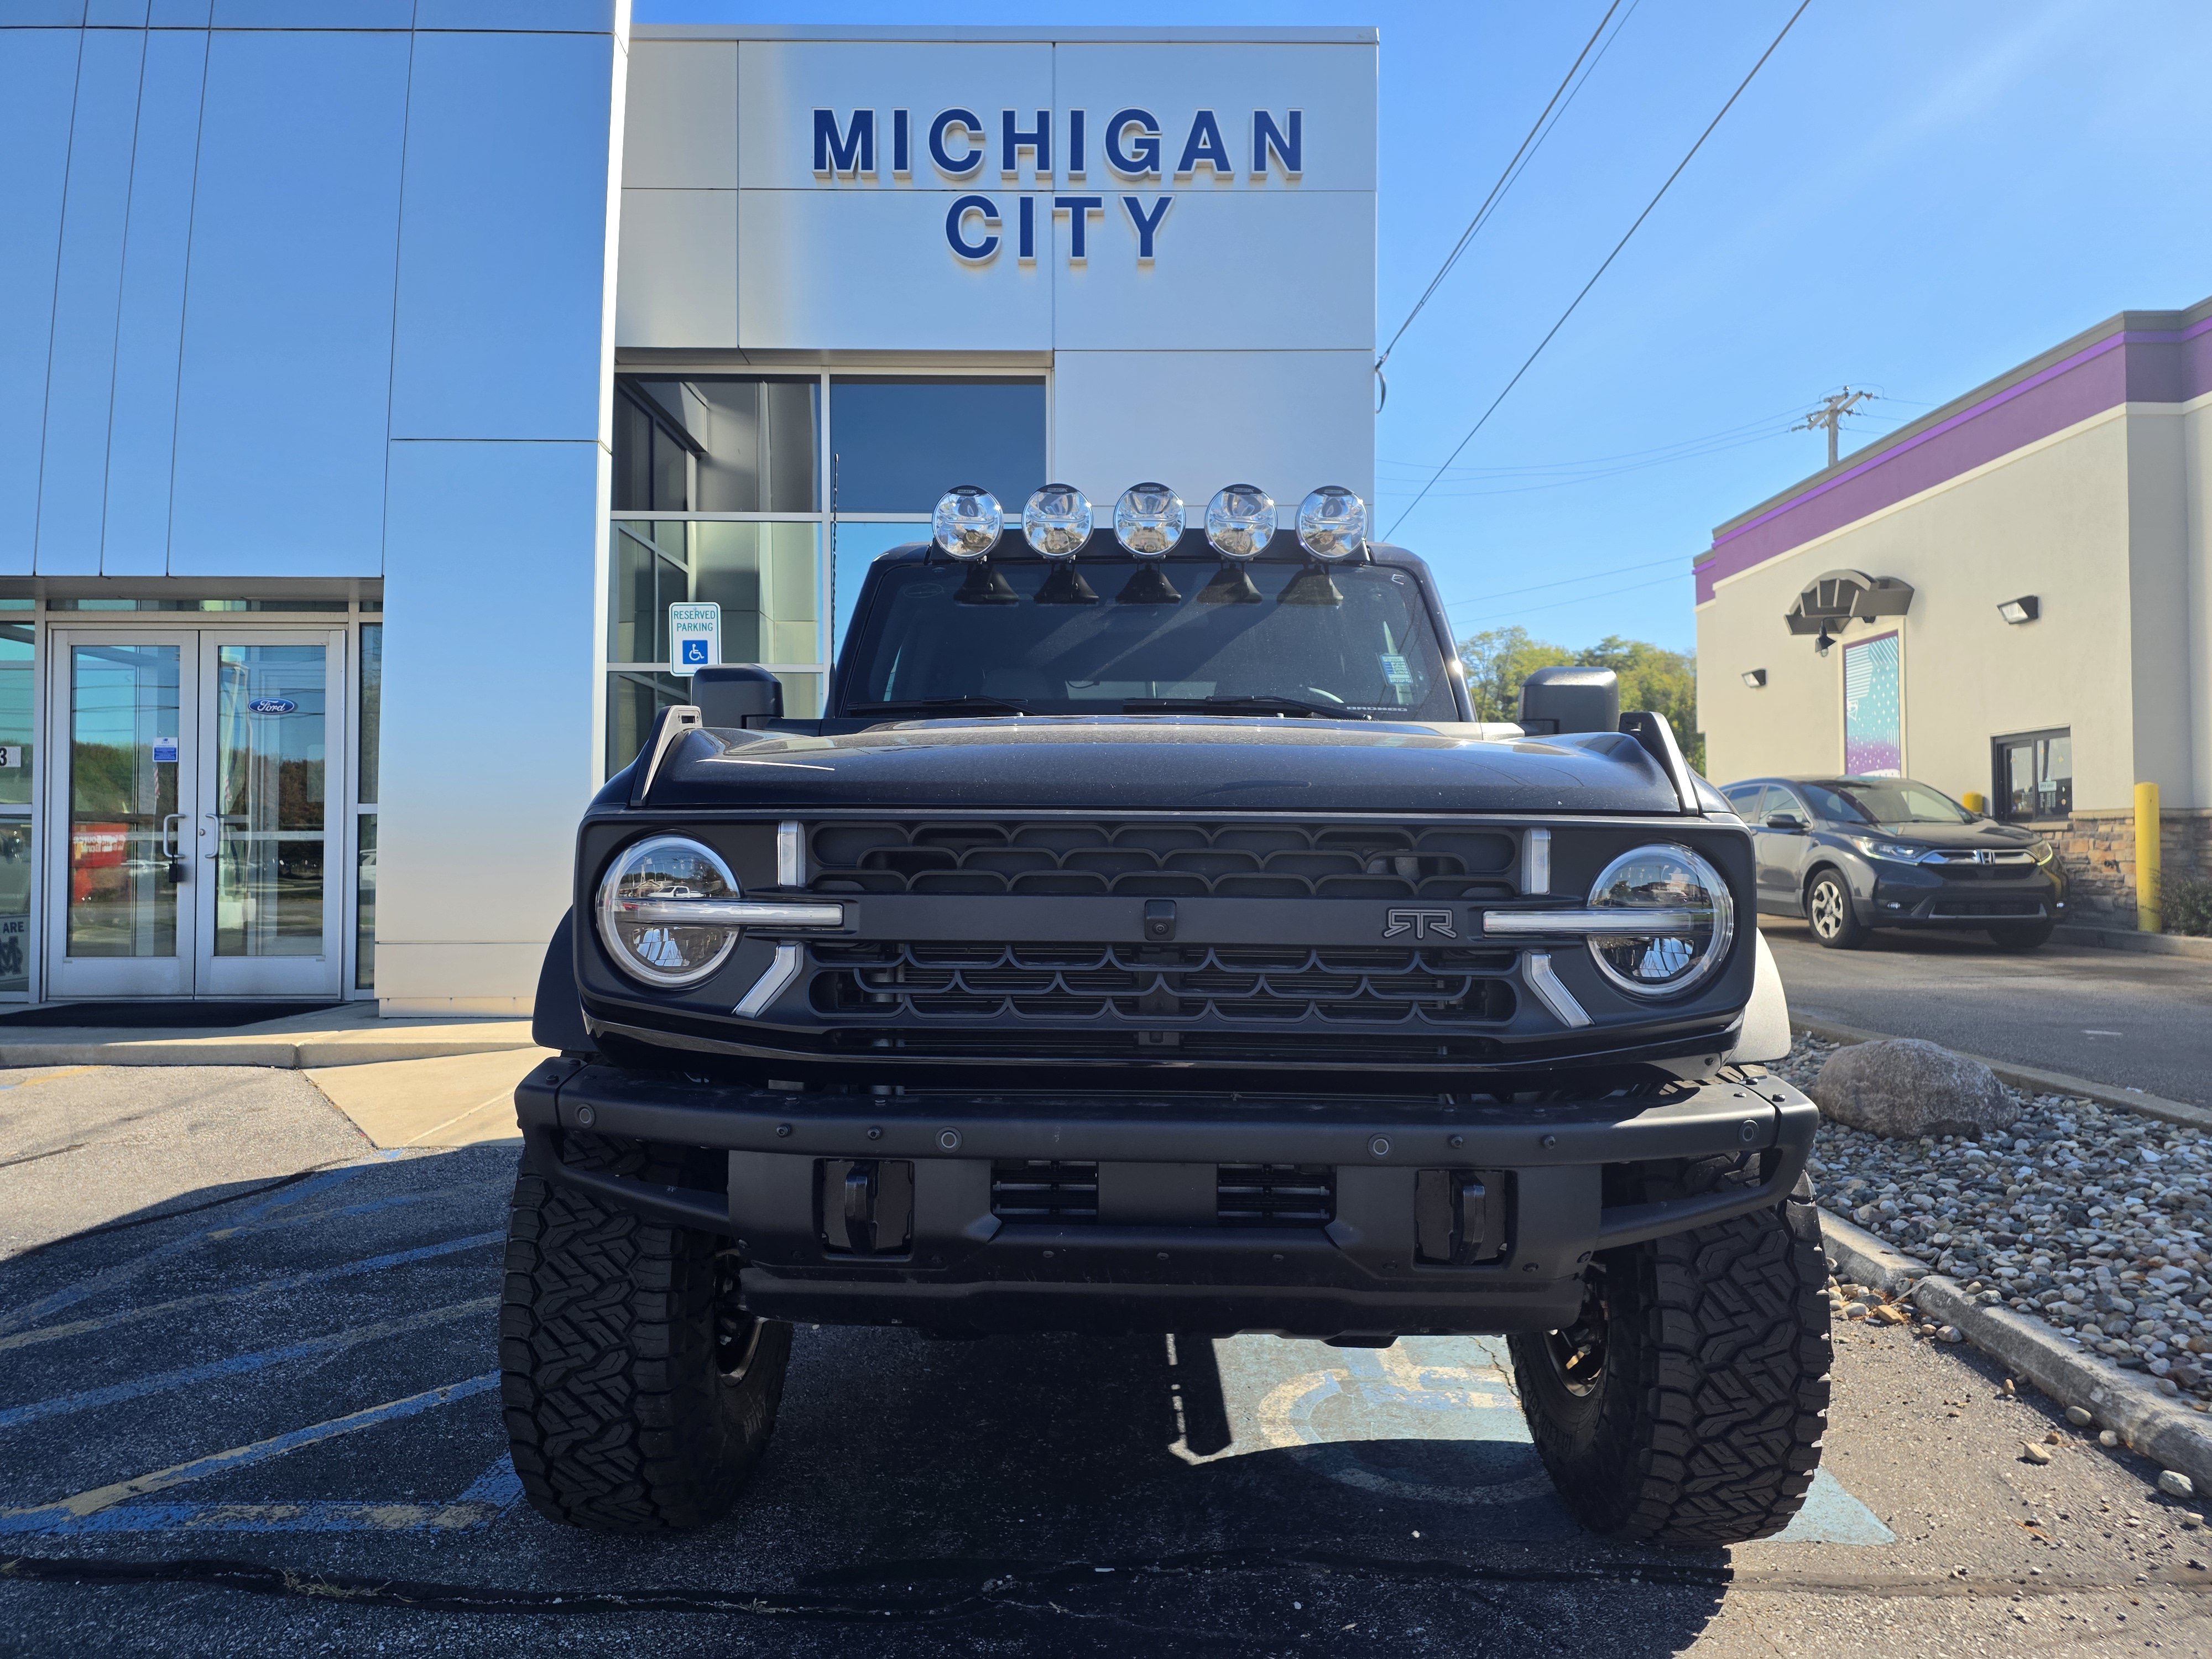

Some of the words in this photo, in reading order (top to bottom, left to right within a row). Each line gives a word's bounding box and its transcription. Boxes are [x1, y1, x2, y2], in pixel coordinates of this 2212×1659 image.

[811, 107, 1303, 179] MICHIGAN
[946, 194, 1175, 265] CITY
[674, 611, 716, 620] RESERVED
[676, 623, 713, 632] PARKING
[257, 700, 286, 712] Ford
[3, 921, 24, 933] ARE
[1382, 907, 1458, 940] RTR
